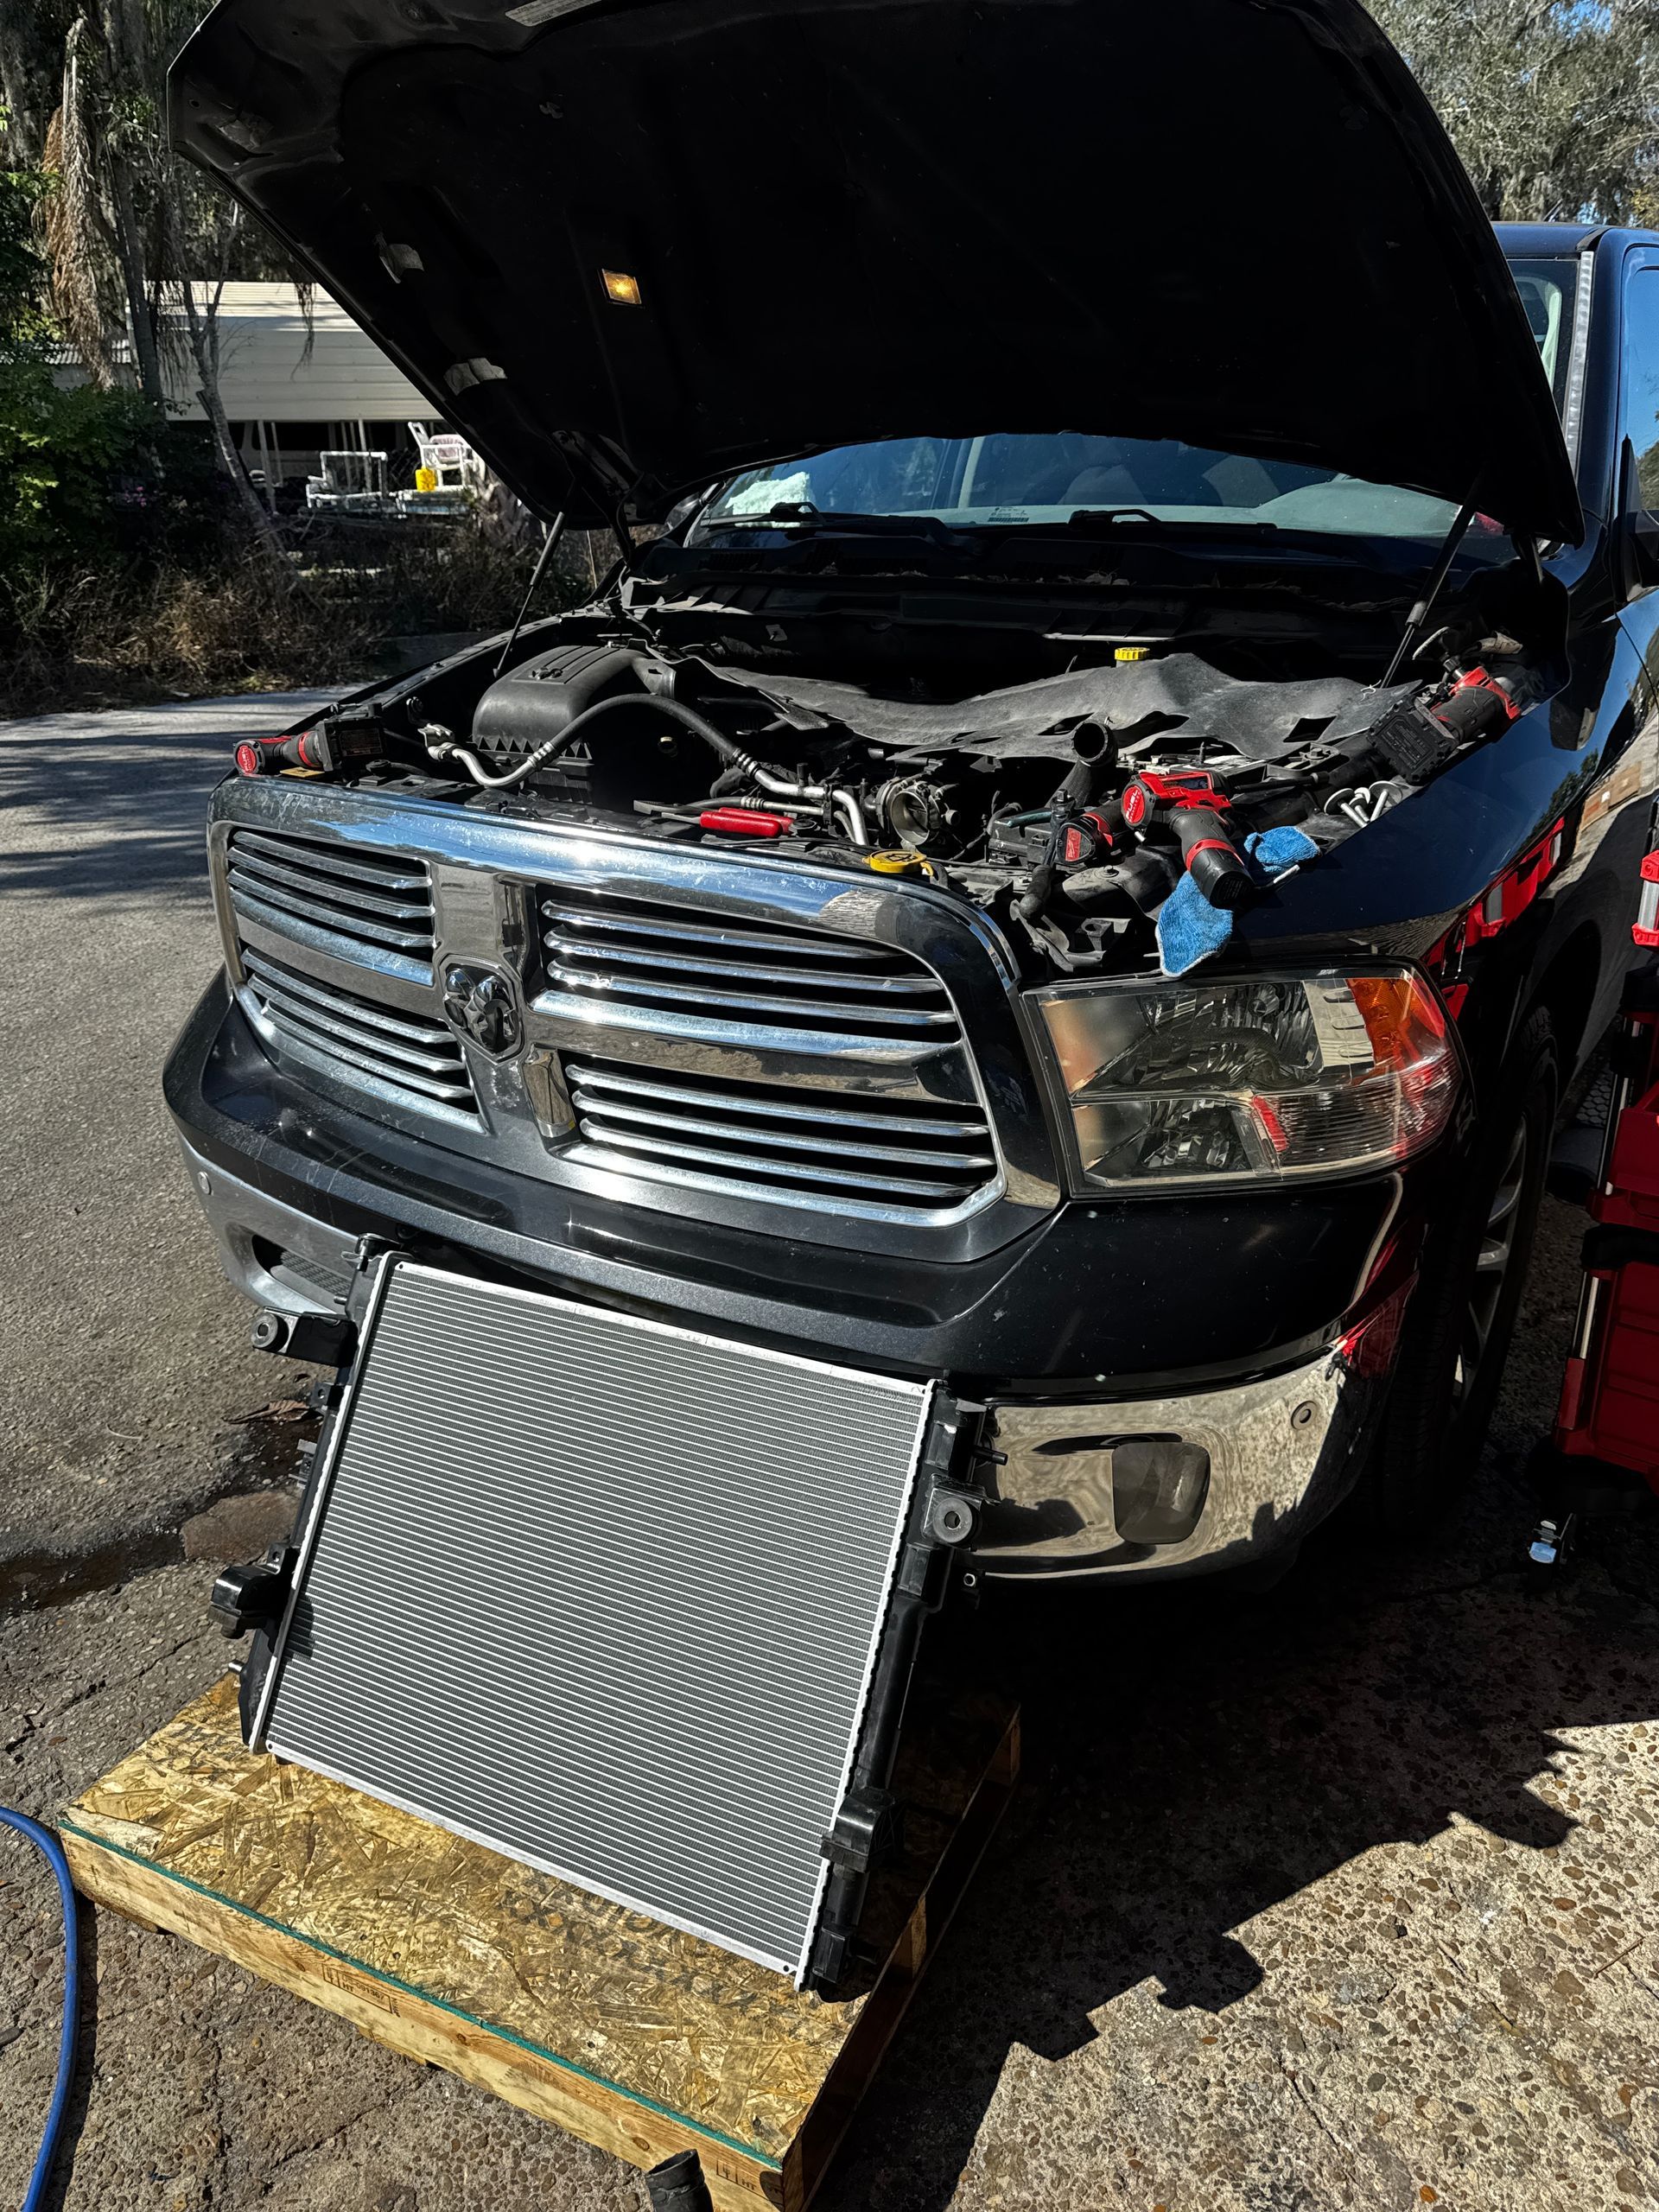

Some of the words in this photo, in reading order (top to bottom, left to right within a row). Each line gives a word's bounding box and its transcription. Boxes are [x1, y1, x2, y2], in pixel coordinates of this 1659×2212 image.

[241, 747, 250, 772] FUEL
[1126, 790, 1138, 820] FUEL
[342, 1982, 354, 1993] HT
[741, 2178, 757, 2190] HT
